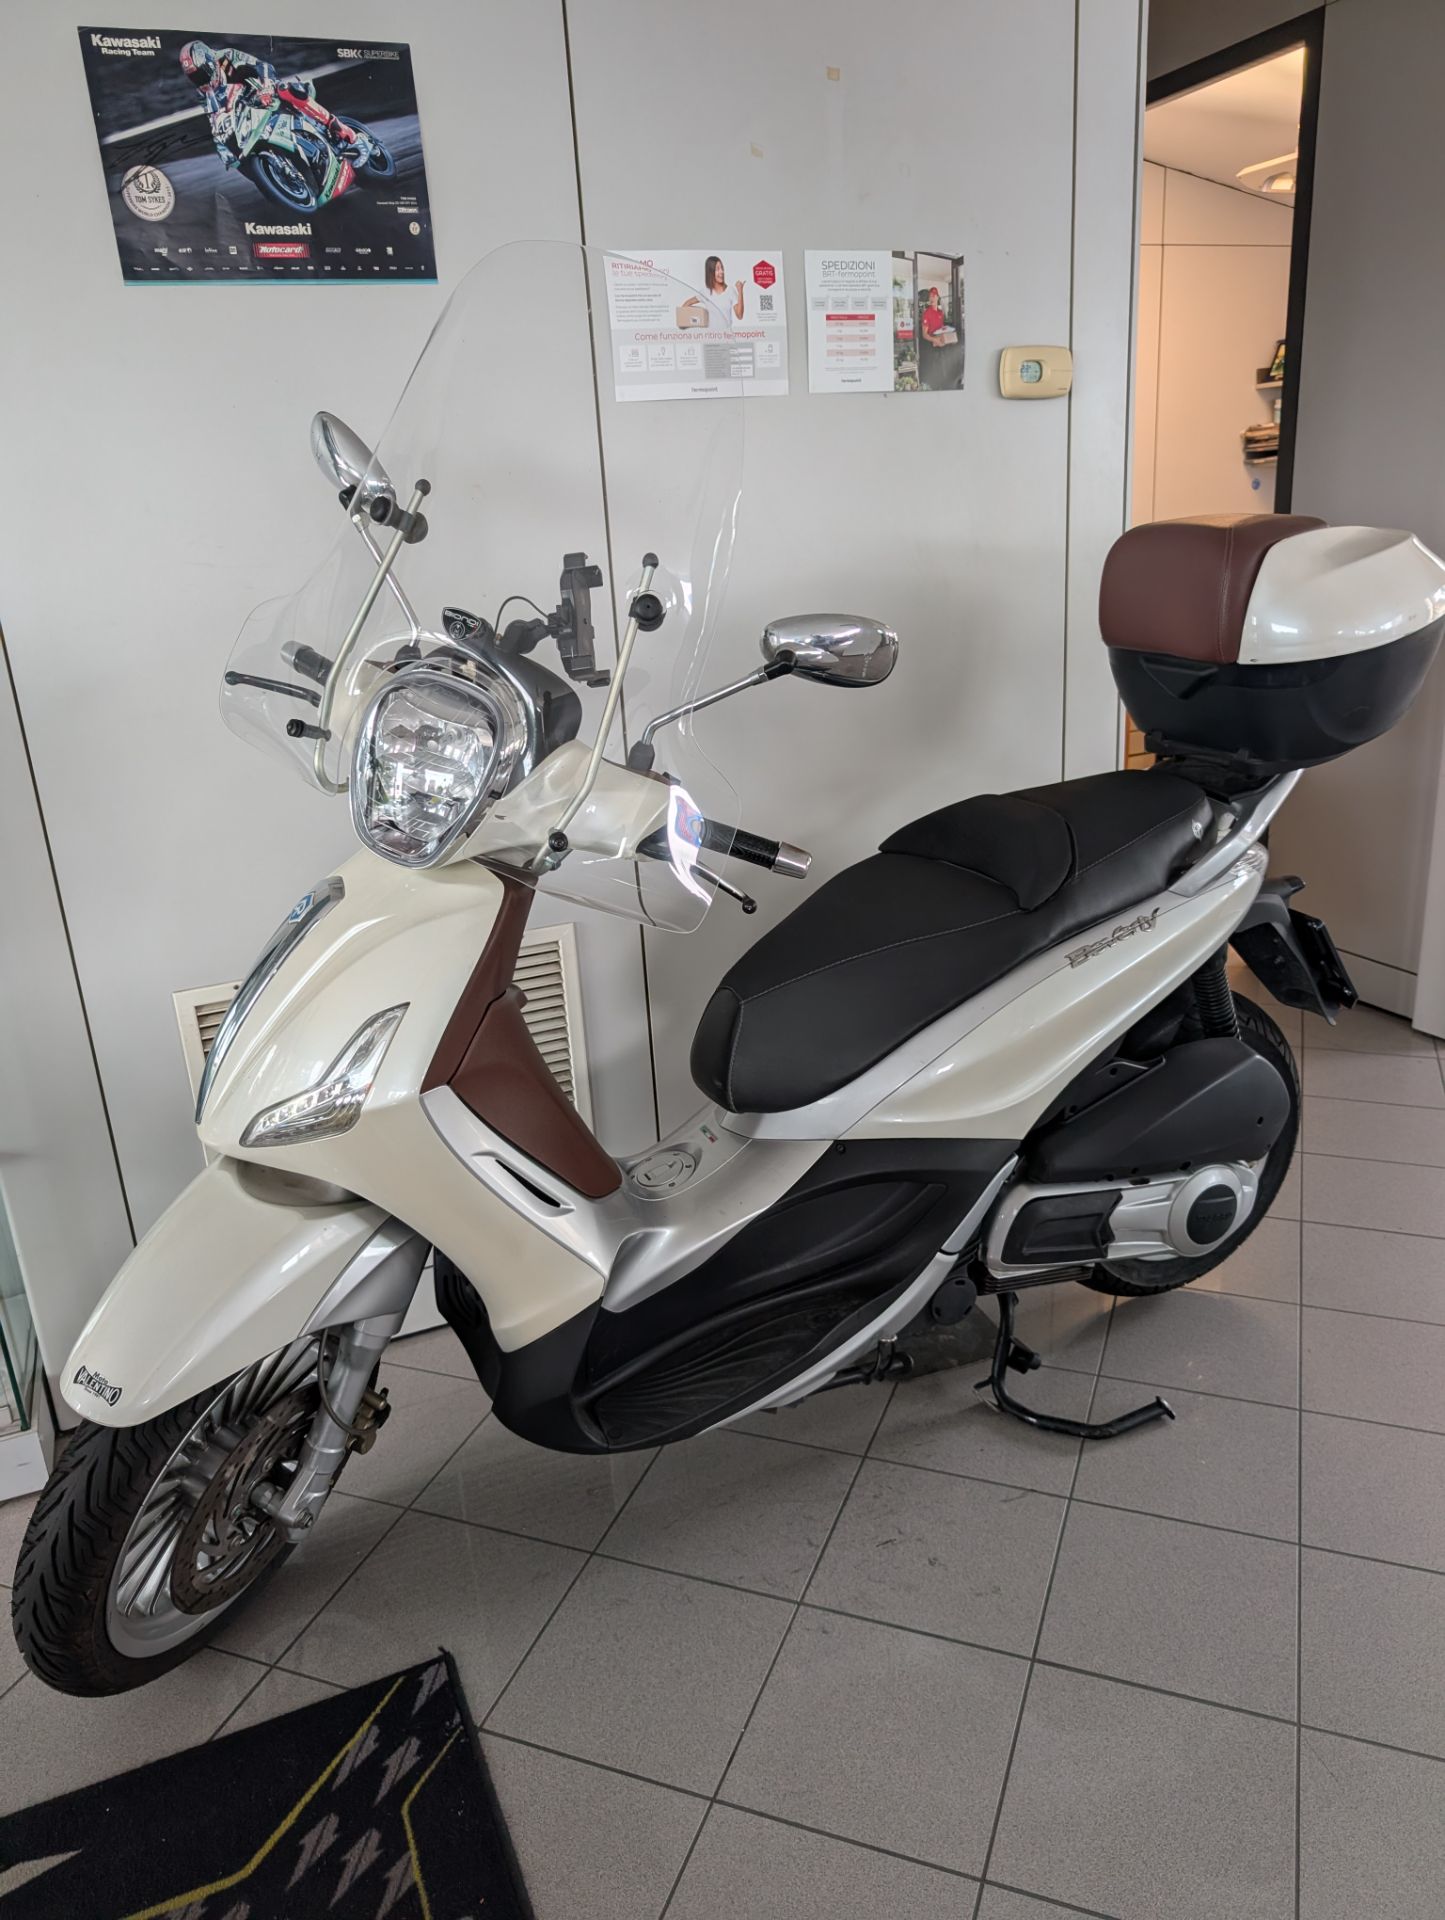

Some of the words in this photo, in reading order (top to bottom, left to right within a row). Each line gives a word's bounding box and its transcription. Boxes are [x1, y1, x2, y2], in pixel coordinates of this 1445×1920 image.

[90, 33, 161, 48] Kawasaki
[101, 47, 131, 56] Racing
[131, 48, 155, 56] Team
[244, 222, 312, 235] Kawasaki
[821, 260, 876, 270] SPEDIZIONI
[634, 332, 659, 341] Come
[659, 331, 692, 341] funziona
[693, 332, 704, 340] un
[704, 331, 723, 340] ritiro
[93, 1371, 109, 1385] Moto
[77, 1367, 120, 1404] VALENTINO
